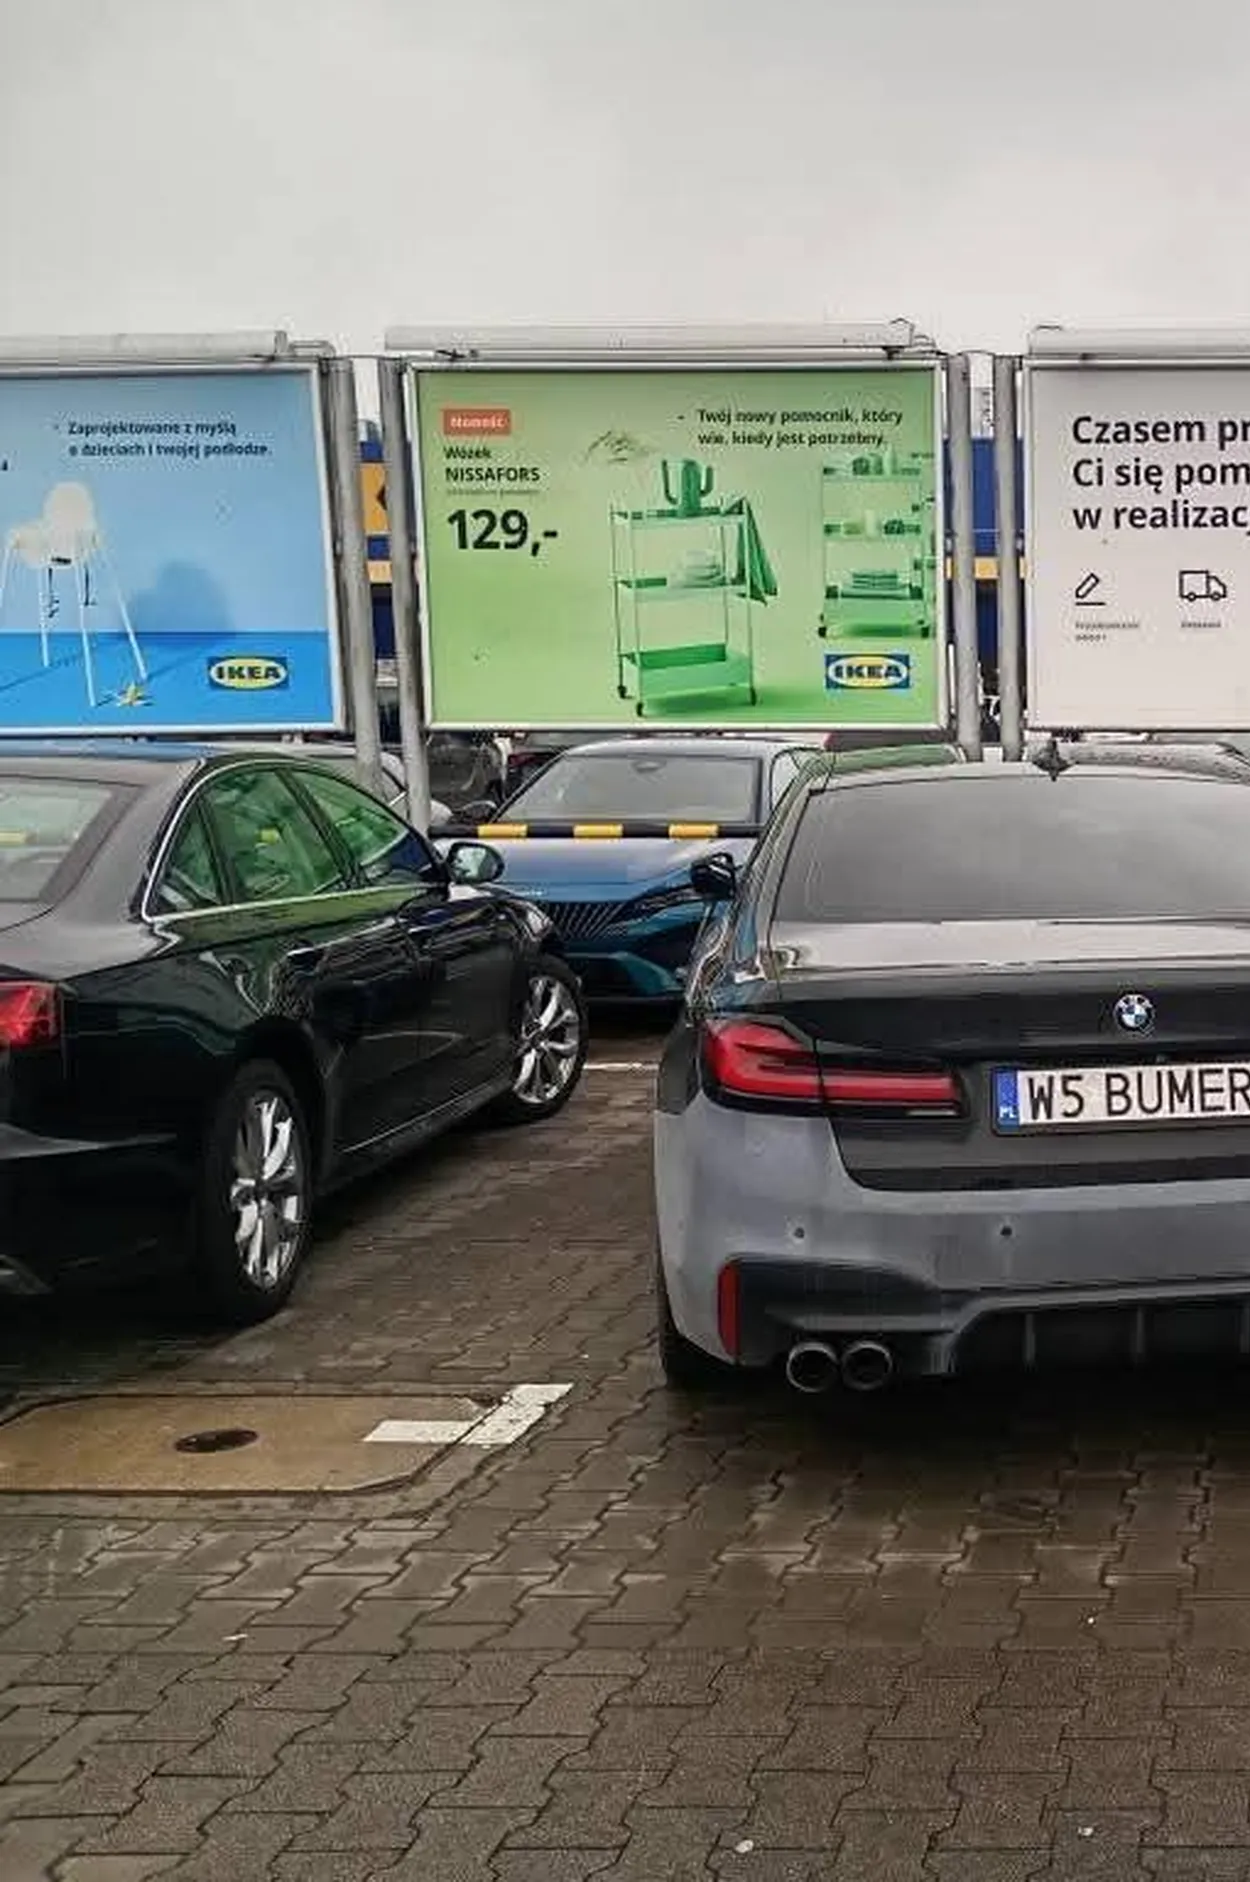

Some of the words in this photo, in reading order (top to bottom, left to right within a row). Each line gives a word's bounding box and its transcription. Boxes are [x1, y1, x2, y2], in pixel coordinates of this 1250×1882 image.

[697, 408, 731, 425] Twój
[736, 411, 776, 425] nowy
[861, 408, 903, 426] który
[1072, 415, 1206, 445] Czasem
[732, 431, 774, 448] kiedy
[776, 431, 804, 448] jest
[445, 467, 541, 482] NISSAFORS
[1072, 457, 1104, 486] Ci
[1115, 456, 1163, 494] się
[1072, 506, 1102, 530] w
[217, 665, 281, 680] IKEA
[834, 664, 902, 679] IKEA
[1027, 1074, 1084, 1121] W5
